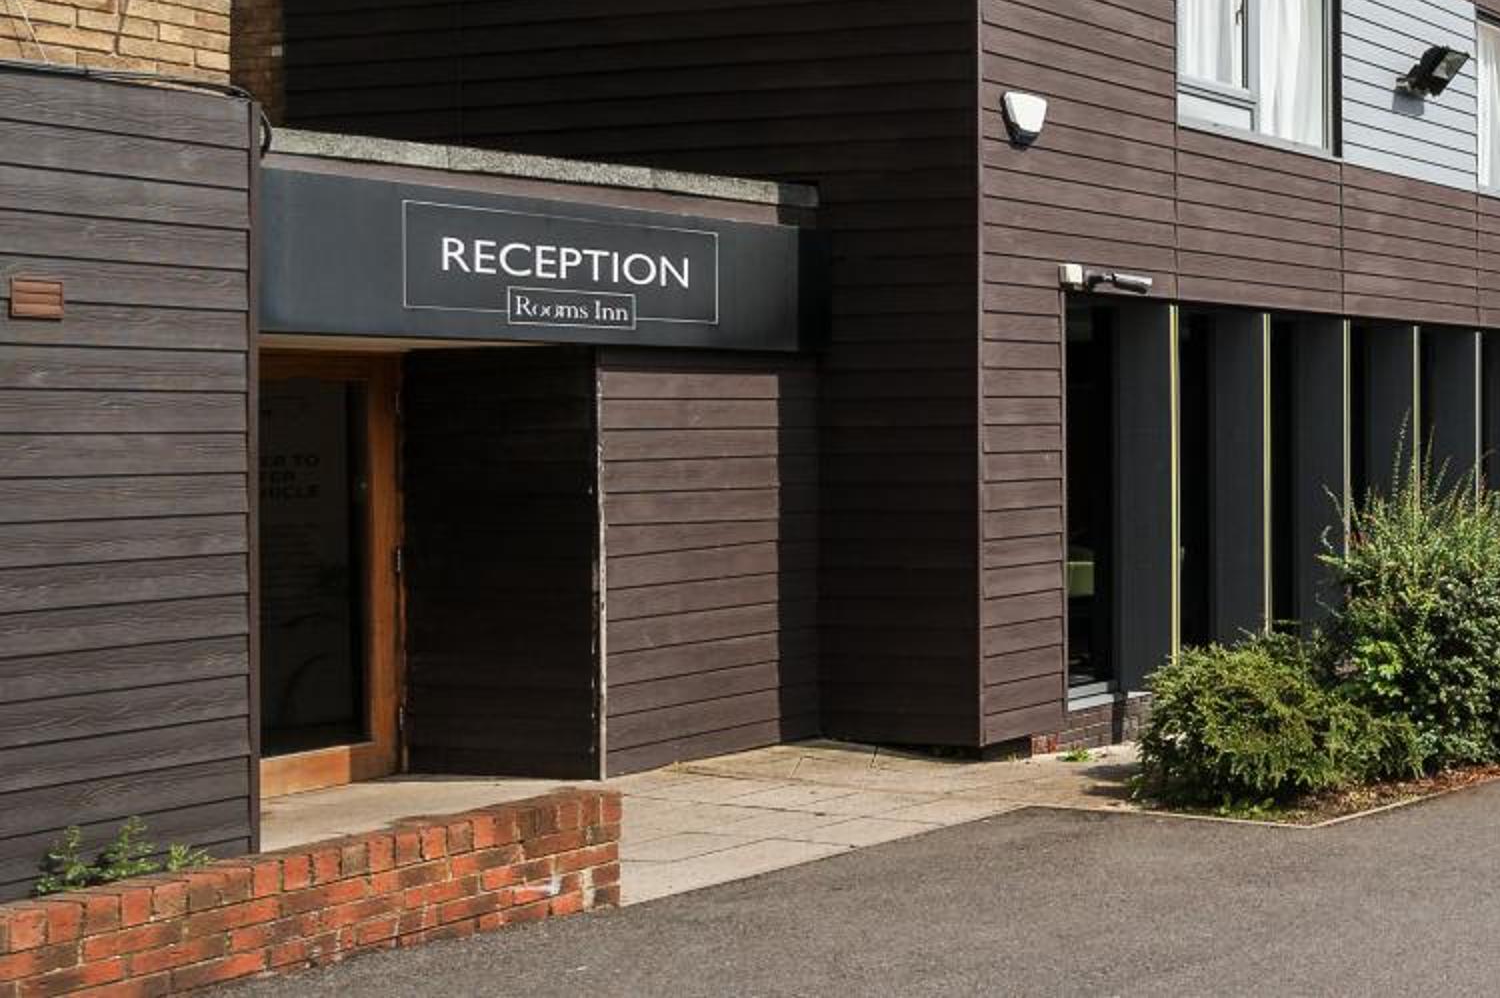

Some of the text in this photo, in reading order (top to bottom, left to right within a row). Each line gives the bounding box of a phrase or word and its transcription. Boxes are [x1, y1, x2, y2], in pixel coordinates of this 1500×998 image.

[441, 237, 689, 289] RECEPTION
[515, 295, 629, 322] Rooms Inn
